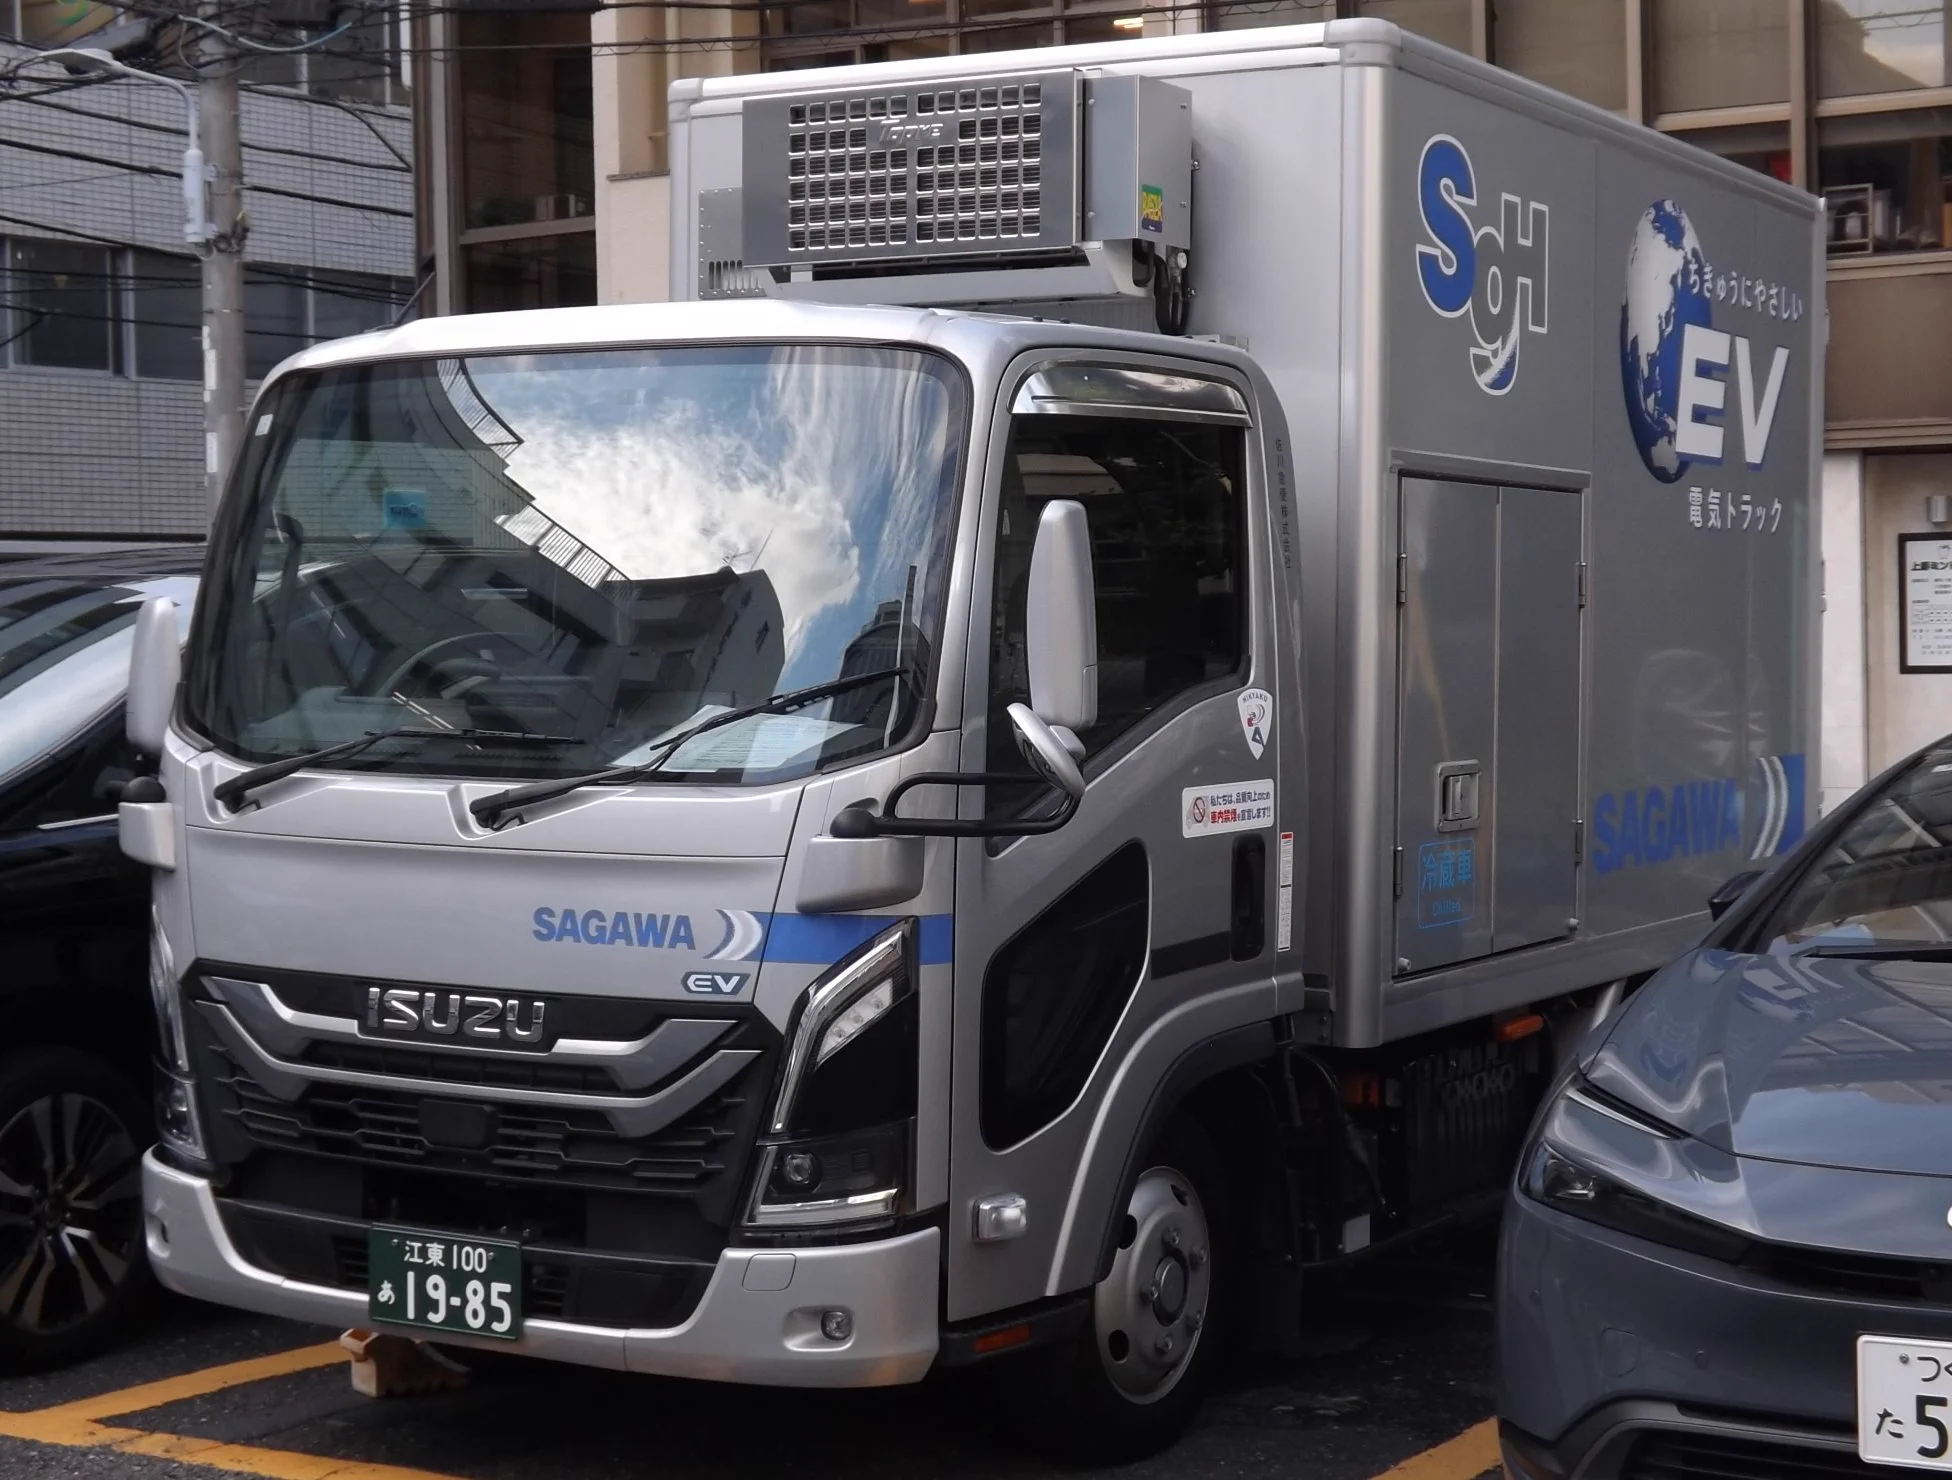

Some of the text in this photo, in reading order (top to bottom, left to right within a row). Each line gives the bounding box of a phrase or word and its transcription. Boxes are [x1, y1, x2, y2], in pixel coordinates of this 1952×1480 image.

[1689, 261, 1803, 321] ちきゅうにやさしい
[1676, 323, 1790, 465] EV
[1689, 486, 1783, 534] 電気トラック
[1593, 776, 1744, 877] SAGAWA
[1422, 850, 1472, 892] 冷蔵車
[532, 906, 697, 951] SAGAWA
[686, 974, 741, 993] EV
[368, 987, 546, 1043] ISUZU
[404, 1240, 487, 1273] 江東 100
[377, 1271, 512, 1332] あ 19-85
[1875, 1394, 1949, 1459] た 5
